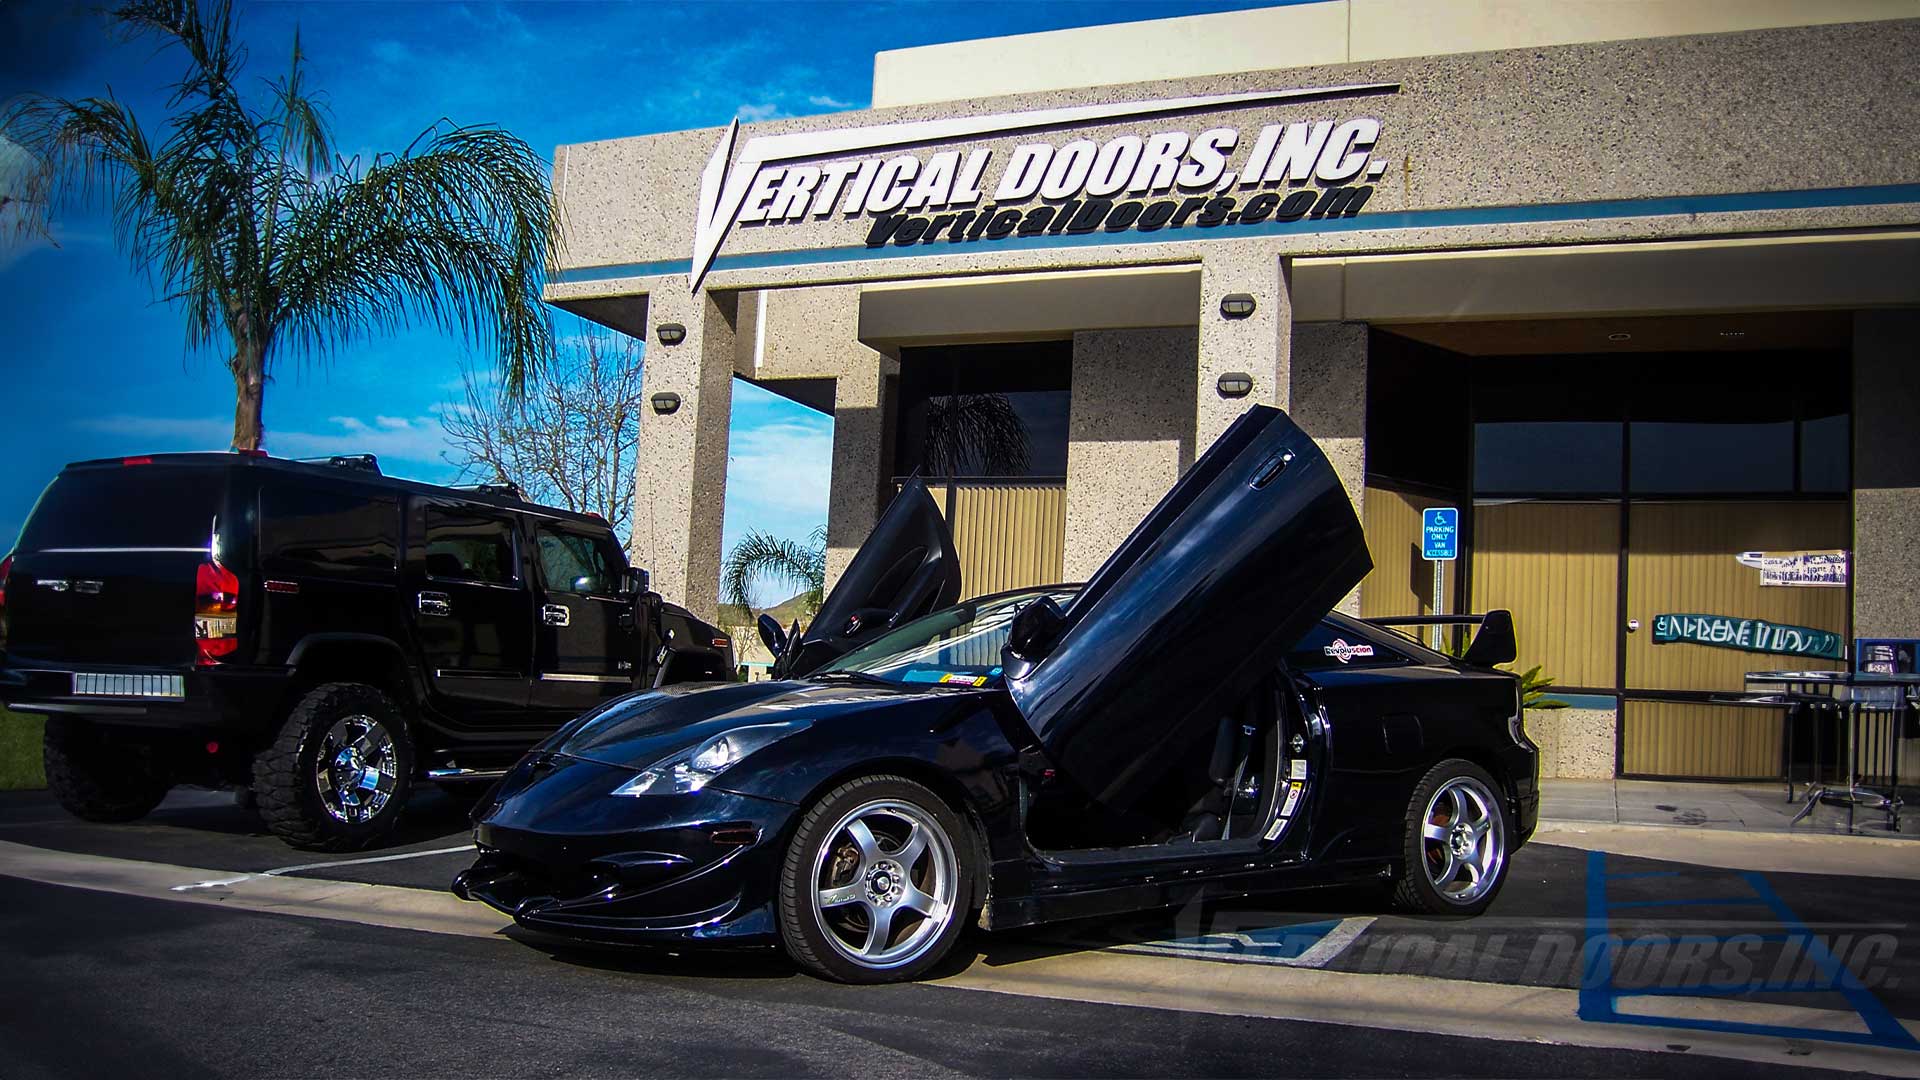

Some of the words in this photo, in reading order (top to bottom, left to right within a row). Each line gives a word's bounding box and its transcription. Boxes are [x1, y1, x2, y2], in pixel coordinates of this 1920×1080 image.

[691, 117, 992, 295] VERTICAL
[865, 184, 1374, 248] VerticalDoors.com
[1425, 525, 1455, 533] PARKING
[1431, 533, 1449, 541] ONLY
[1433, 541, 1446, 549] VAN
